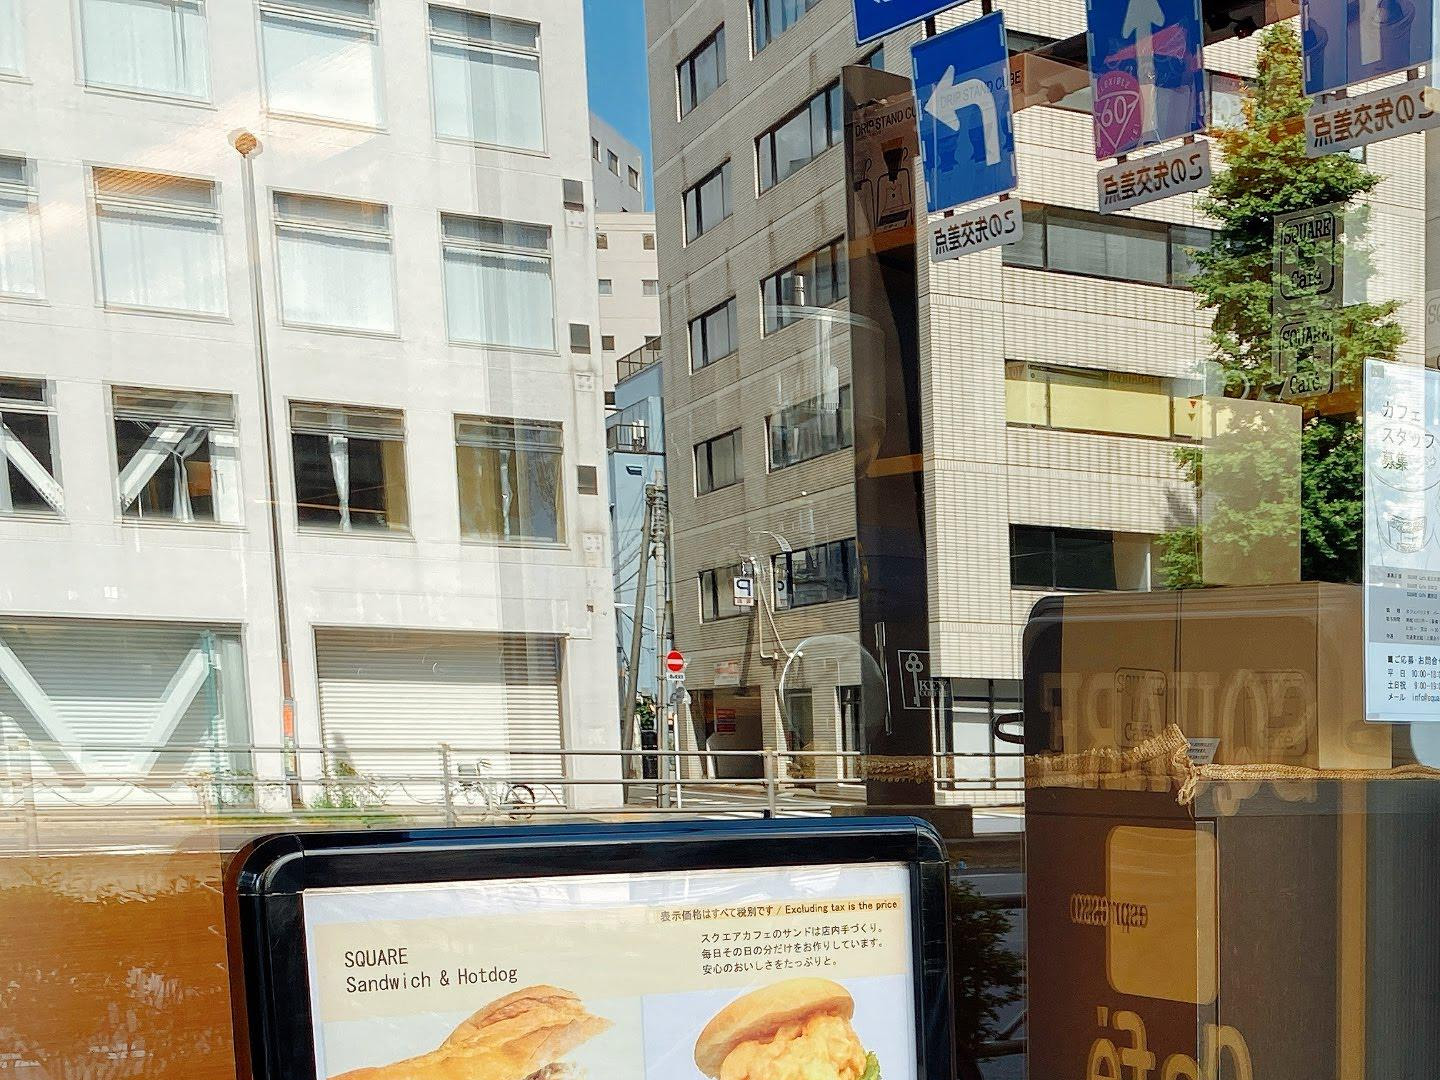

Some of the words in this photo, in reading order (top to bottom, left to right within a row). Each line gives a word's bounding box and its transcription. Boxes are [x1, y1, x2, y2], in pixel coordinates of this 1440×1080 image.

[874, 110, 905, 131] STAND
[660, 905, 774, 922] 表示価格はすべて税別です
[785, 903, 829, 915] Excluding
[830, 902, 846, 912] tax
[848, 901, 856, 911] is
[858, 900, 873, 910] the
[875, 900, 898, 912] price
[701, 922, 883, 944] スクエアカフェのサンドは店内手づくり。
[344, 947, 409, 968] SQUARE
[702, 937, 883, 960] 毎日その日の分だけをお作りしています。
[702, 955, 838, 976] 安心のおいしさをたっぷりと。
[345, 971, 431, 993] Sandwich
[439, 970, 450, 987] &
[457, 966, 518, 985] Hotdog
